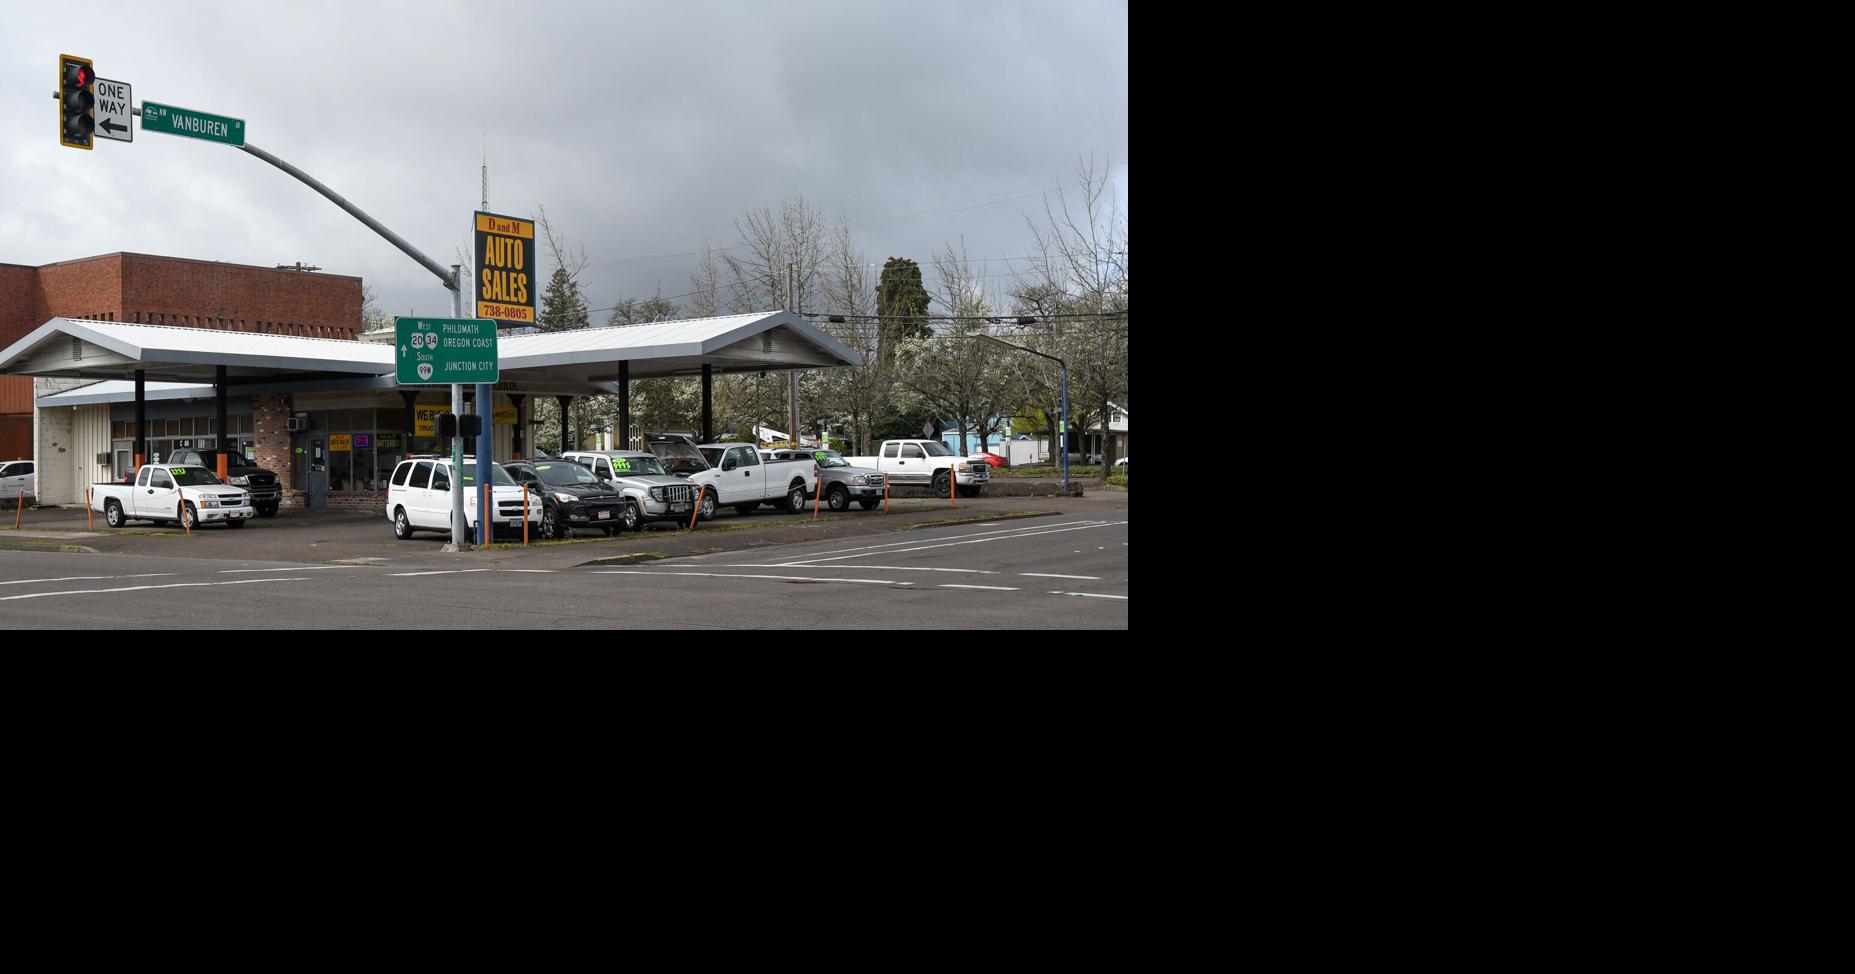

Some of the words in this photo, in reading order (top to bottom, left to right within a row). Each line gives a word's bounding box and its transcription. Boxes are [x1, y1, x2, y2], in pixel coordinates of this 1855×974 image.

[98, 82, 125, 100] ONE
[98, 98, 126, 116] WAY
[171, 113, 228, 137] VANBUREN
[488, 218, 495, 230] D
[497, 223, 510, 233] and
[511, 221, 520, 235] M
[485, 235, 524, 270] AUTO
[482, 268, 527, 304] SALES
[484, 305, 527, 320] 738-0805
[442, 324, 479, 334] PHILOMATH
[412, 335, 422, 345] 20
[426, 335, 437, 345] 34
[443, 338, 470, 348] OREGON
[472, 338, 493, 348] COAST
[419, 366, 431, 374] 99W
[444, 361, 477, 371] JUNCTION
[478, 361, 493, 370] CITY
[416, 409, 428, 421] WE
